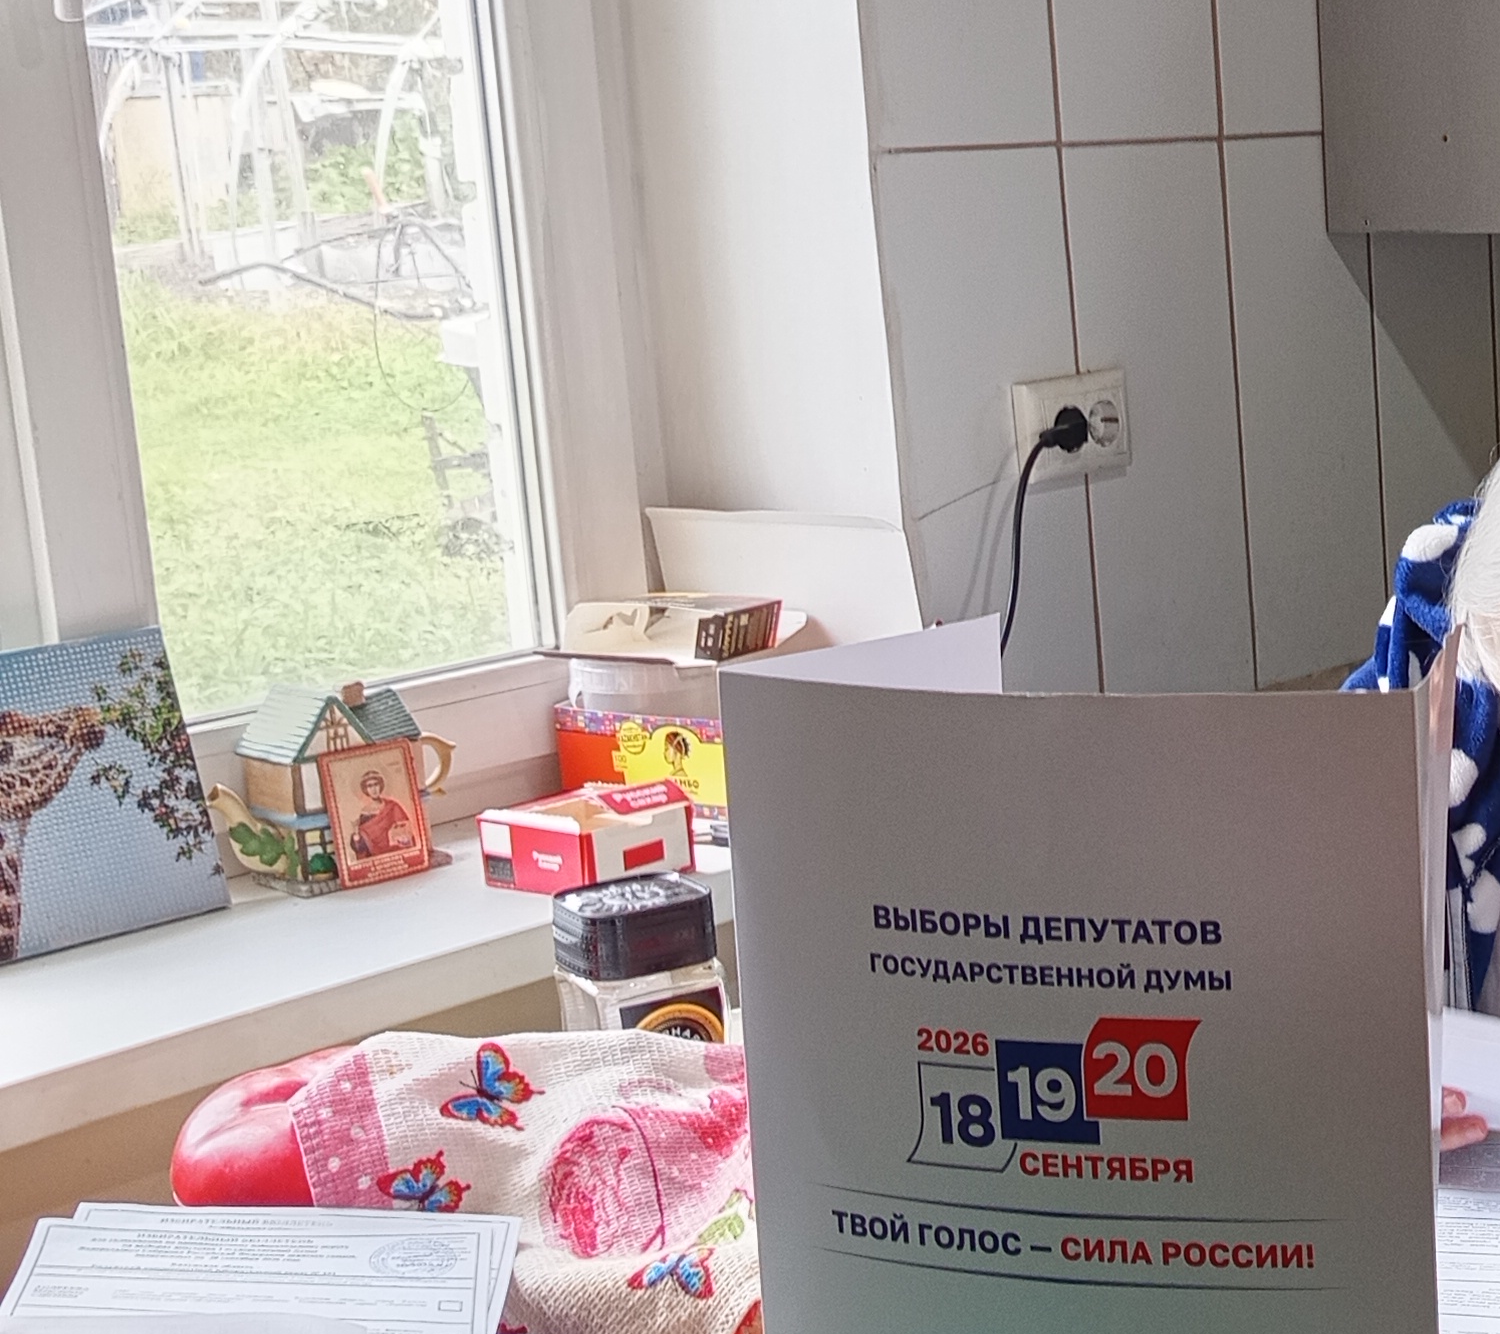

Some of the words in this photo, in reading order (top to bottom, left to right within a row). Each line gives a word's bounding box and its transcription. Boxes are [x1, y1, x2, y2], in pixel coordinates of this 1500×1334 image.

[873, 905, 1010, 940] ВЫБОРЫ
[1020, 915, 1222, 946] ДЕПУТАТОВ
[870, 953, 1135, 990] ГОСУДАРСТВЕННОЙ
[1143, 968, 1232, 994] ДУМЫ
[917, 1028, 990, 1057] 2026
[930, 1092, 996, 1148] 18
[1007, 1066, 1076, 1123] 19
[1092, 1041, 1178, 1098] 20
[1019, 1152, 1194, 1183] СЕНТЯБРЯ
[832, 1209, 909, 1245] ТВОЙ
[918, 1223, 1022, 1256] ГОЛОС
[1060, 1236, 1152, 1265] СИЛА
[1162, 1240, 1315, 1269] РОССИИ!
